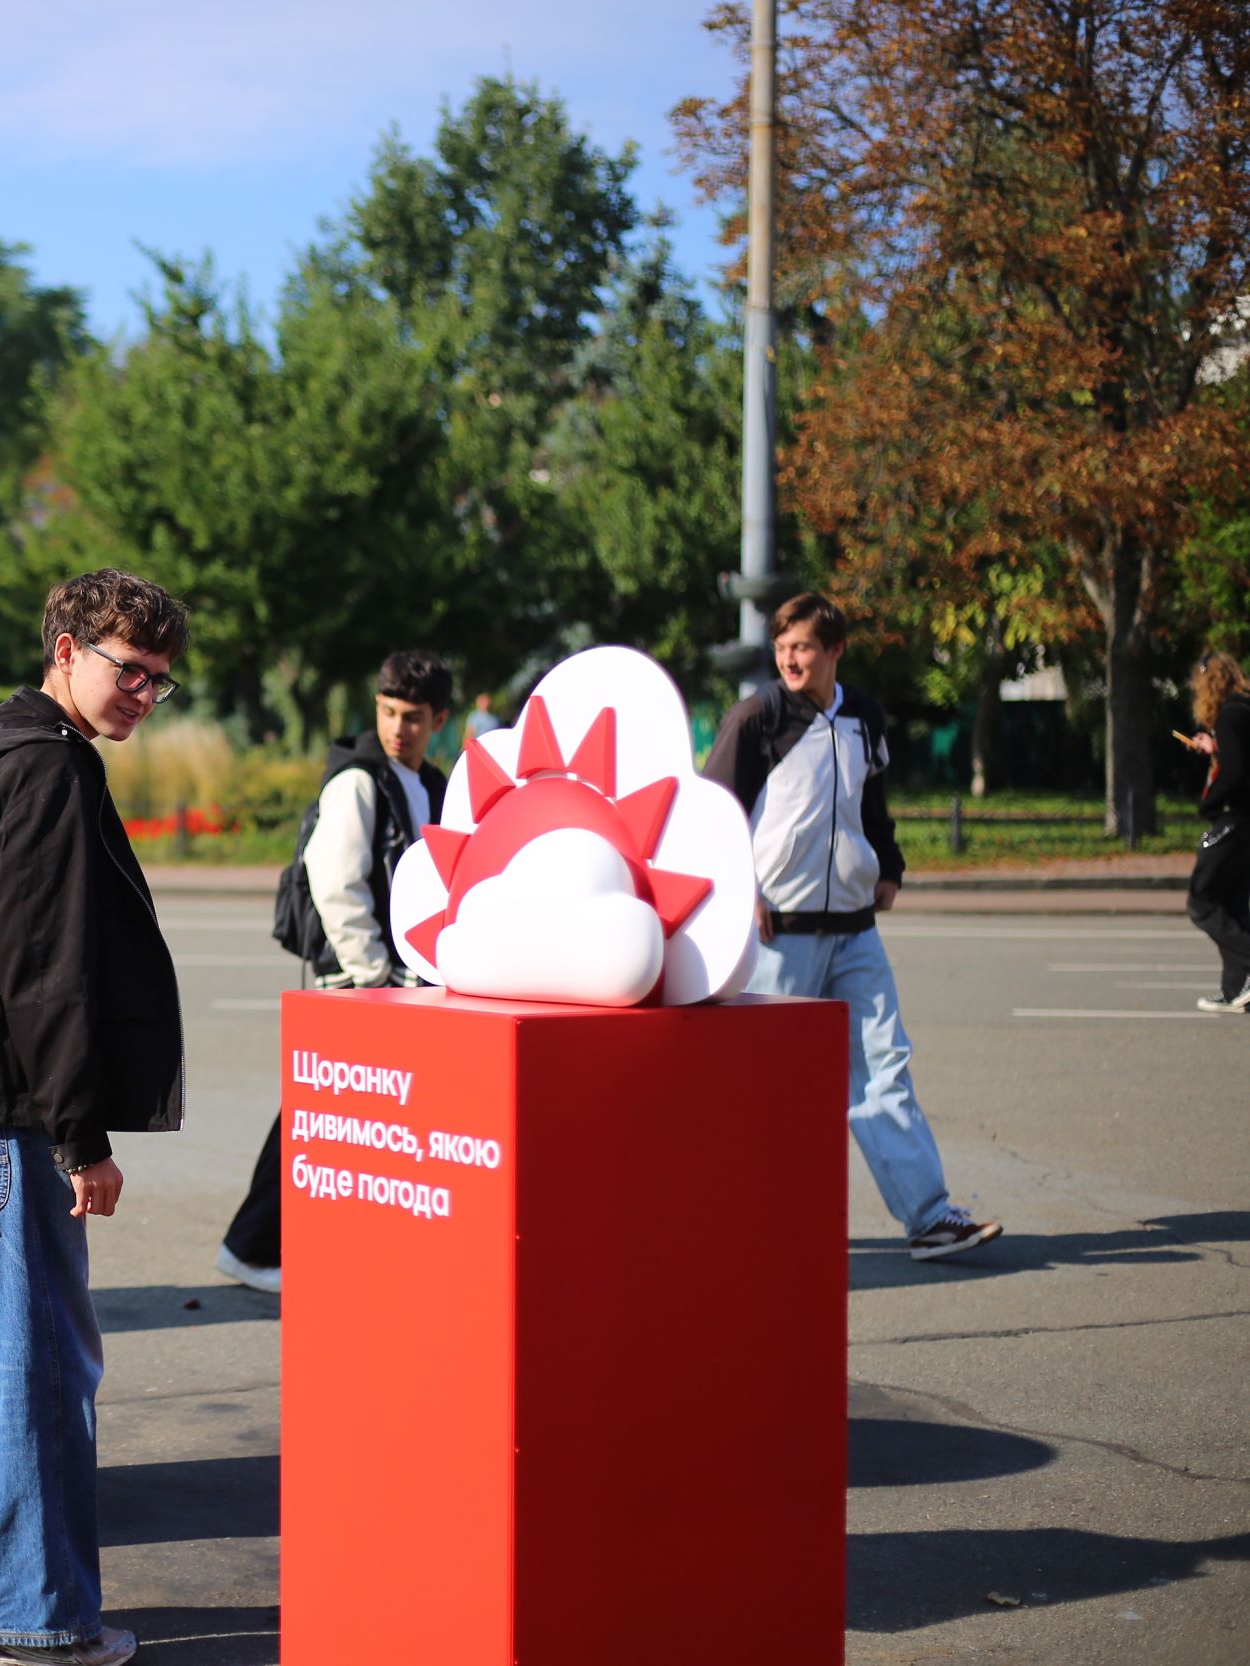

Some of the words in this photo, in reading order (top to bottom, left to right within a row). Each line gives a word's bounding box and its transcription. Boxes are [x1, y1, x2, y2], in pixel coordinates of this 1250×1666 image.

[292, 1049, 413, 1105] Щоранку
[291, 1110, 423, 1162] дивимось,
[429, 1130, 501, 1169] якою
[291, 1154, 354, 1200] буде
[358, 1172, 451, 1219] погода
